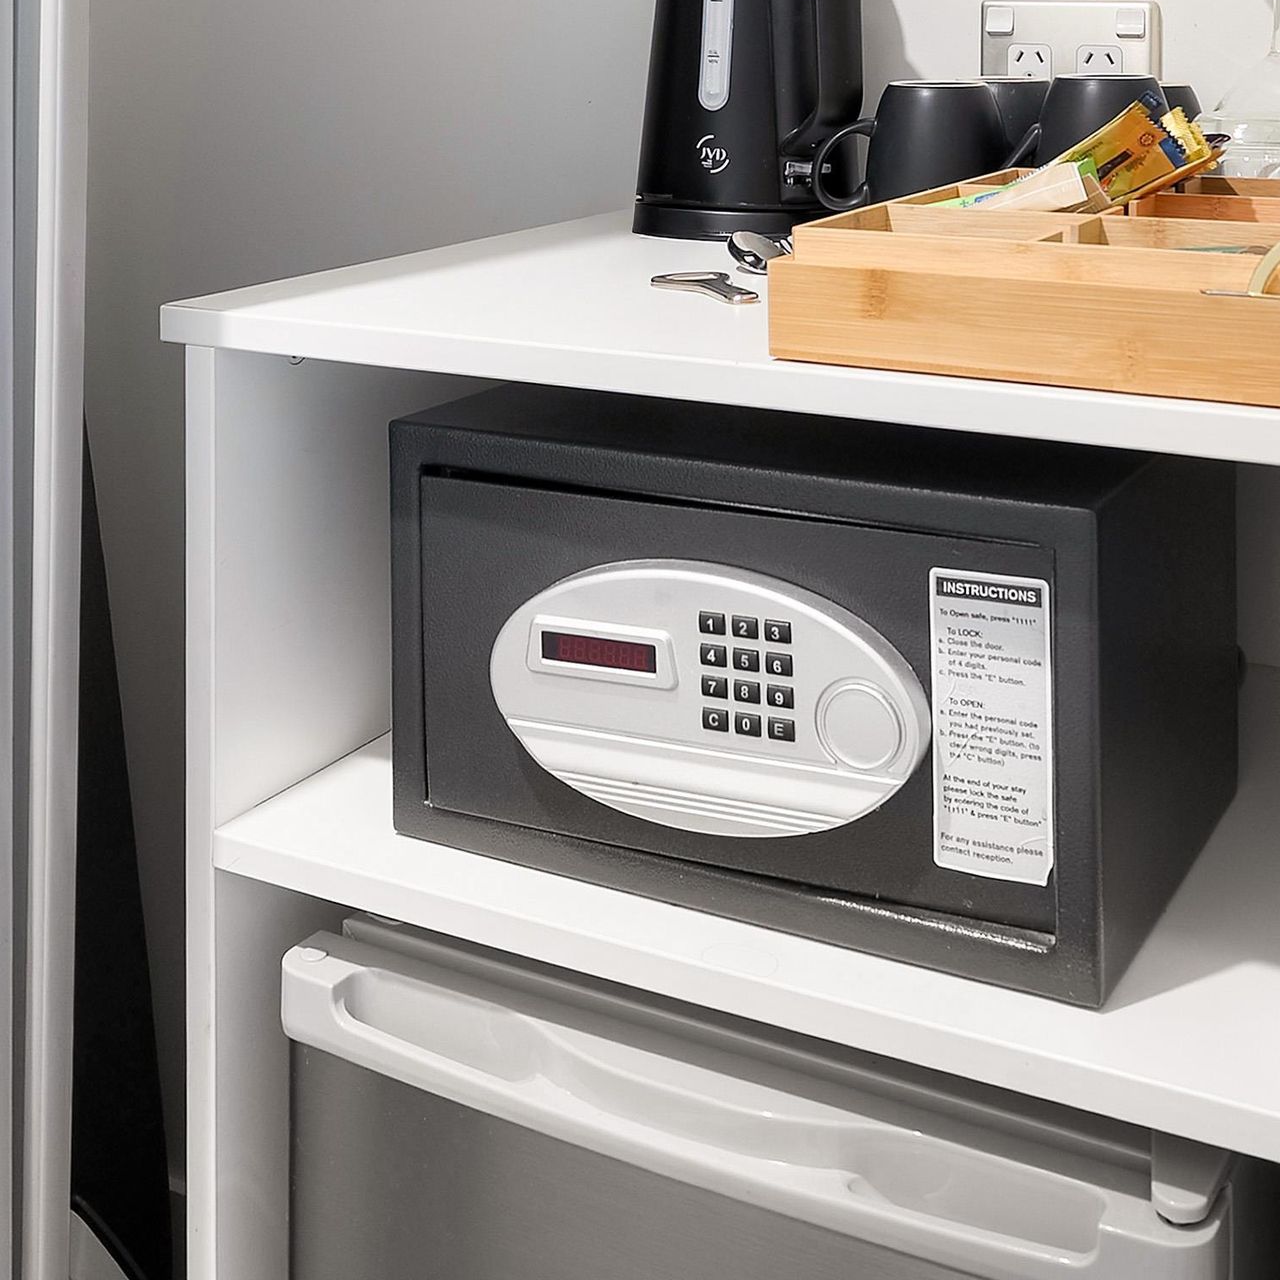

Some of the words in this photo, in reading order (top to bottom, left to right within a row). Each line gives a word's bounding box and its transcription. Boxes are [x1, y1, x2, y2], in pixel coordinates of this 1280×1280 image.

[943, 581, 1036, 603] INSTRUCTIONS
[950, 610, 969, 618] Open
[990, 615, 1010, 623] press
[706, 618, 714, 631] 1
[739, 622, 748, 635] 2
[771, 627, 779, 640] 3
[947, 627, 956, 635] To
[947, 637, 968, 646] Close
[971, 640, 983, 648] the
[707, 649, 716, 663] 4
[741, 655, 749, 667] 5
[773, 660, 782, 673] 6
[948, 648, 967, 657] Enter
[988, 653, 1020, 664] personal
[1023, 658, 1041, 667] code
[948, 669, 968, 678] Press
[970, 672, 982, 680] the
[707, 681, 716, 694] 7
[741, 685, 749, 699] 8
[774, 692, 784, 705] 9
[709, 713, 719, 726] C
[742, 718, 750, 731] 0
[774, 723, 784, 736] E
[948, 709, 968, 717] Enter
[971, 712, 982, 720] the
[985, 714, 1016, 725] personal
[1019, 720, 1038, 728] code
[980, 725, 1018, 737] previously
[948, 730, 968, 739] Press
[971, 733, 983, 741] the
[1029, 742, 1039, 751] (to
[970, 744, 992, 754] wrong
[1020, 752, 1042, 761] press
[978, 755, 1005, 767] button)
[943, 785, 967, 794] please
[970, 788, 984, 797] lock
[987, 791, 999, 800] the
[1002, 794, 1017, 802] safe
[982, 780, 990, 788] of
[992, 783, 1008, 791] your
[1011, 786, 1026, 795] stay
[943, 795, 952, 803] by
[954, 798, 984, 808] entering
[986, 802, 998, 810] the
[1000, 804, 1019, 813] code
[978, 811, 998, 821] press
[940, 832, 953, 841] For
[956, 837, 969, 846] any
[972, 839, 1014, 853] assistance
[1017, 846, 1044, 856] please
[941, 844, 971, 856] contact
[973, 851, 1013, 864] reception.
